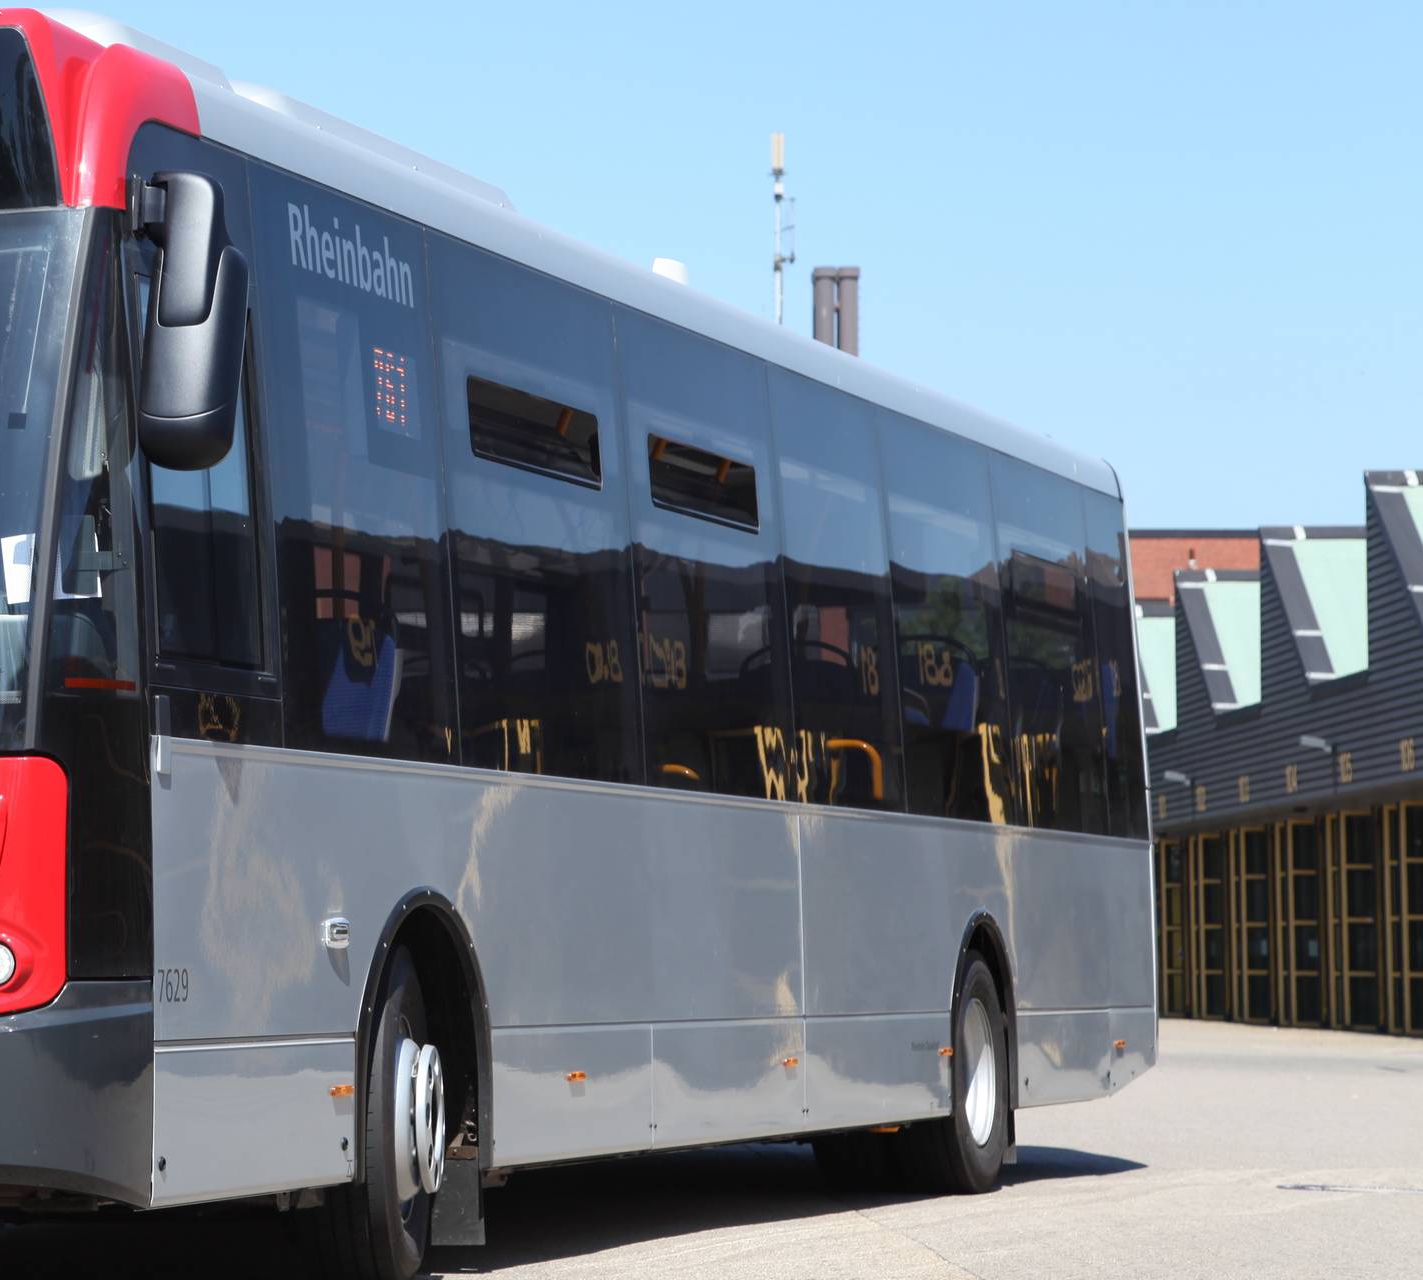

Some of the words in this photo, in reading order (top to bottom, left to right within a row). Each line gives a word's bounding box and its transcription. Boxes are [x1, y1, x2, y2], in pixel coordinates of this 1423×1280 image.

[287, 201, 414, 309] Rheinbahn
[373, 347, 406, 427] 761
[157, 968, 189, 1003] 7629
